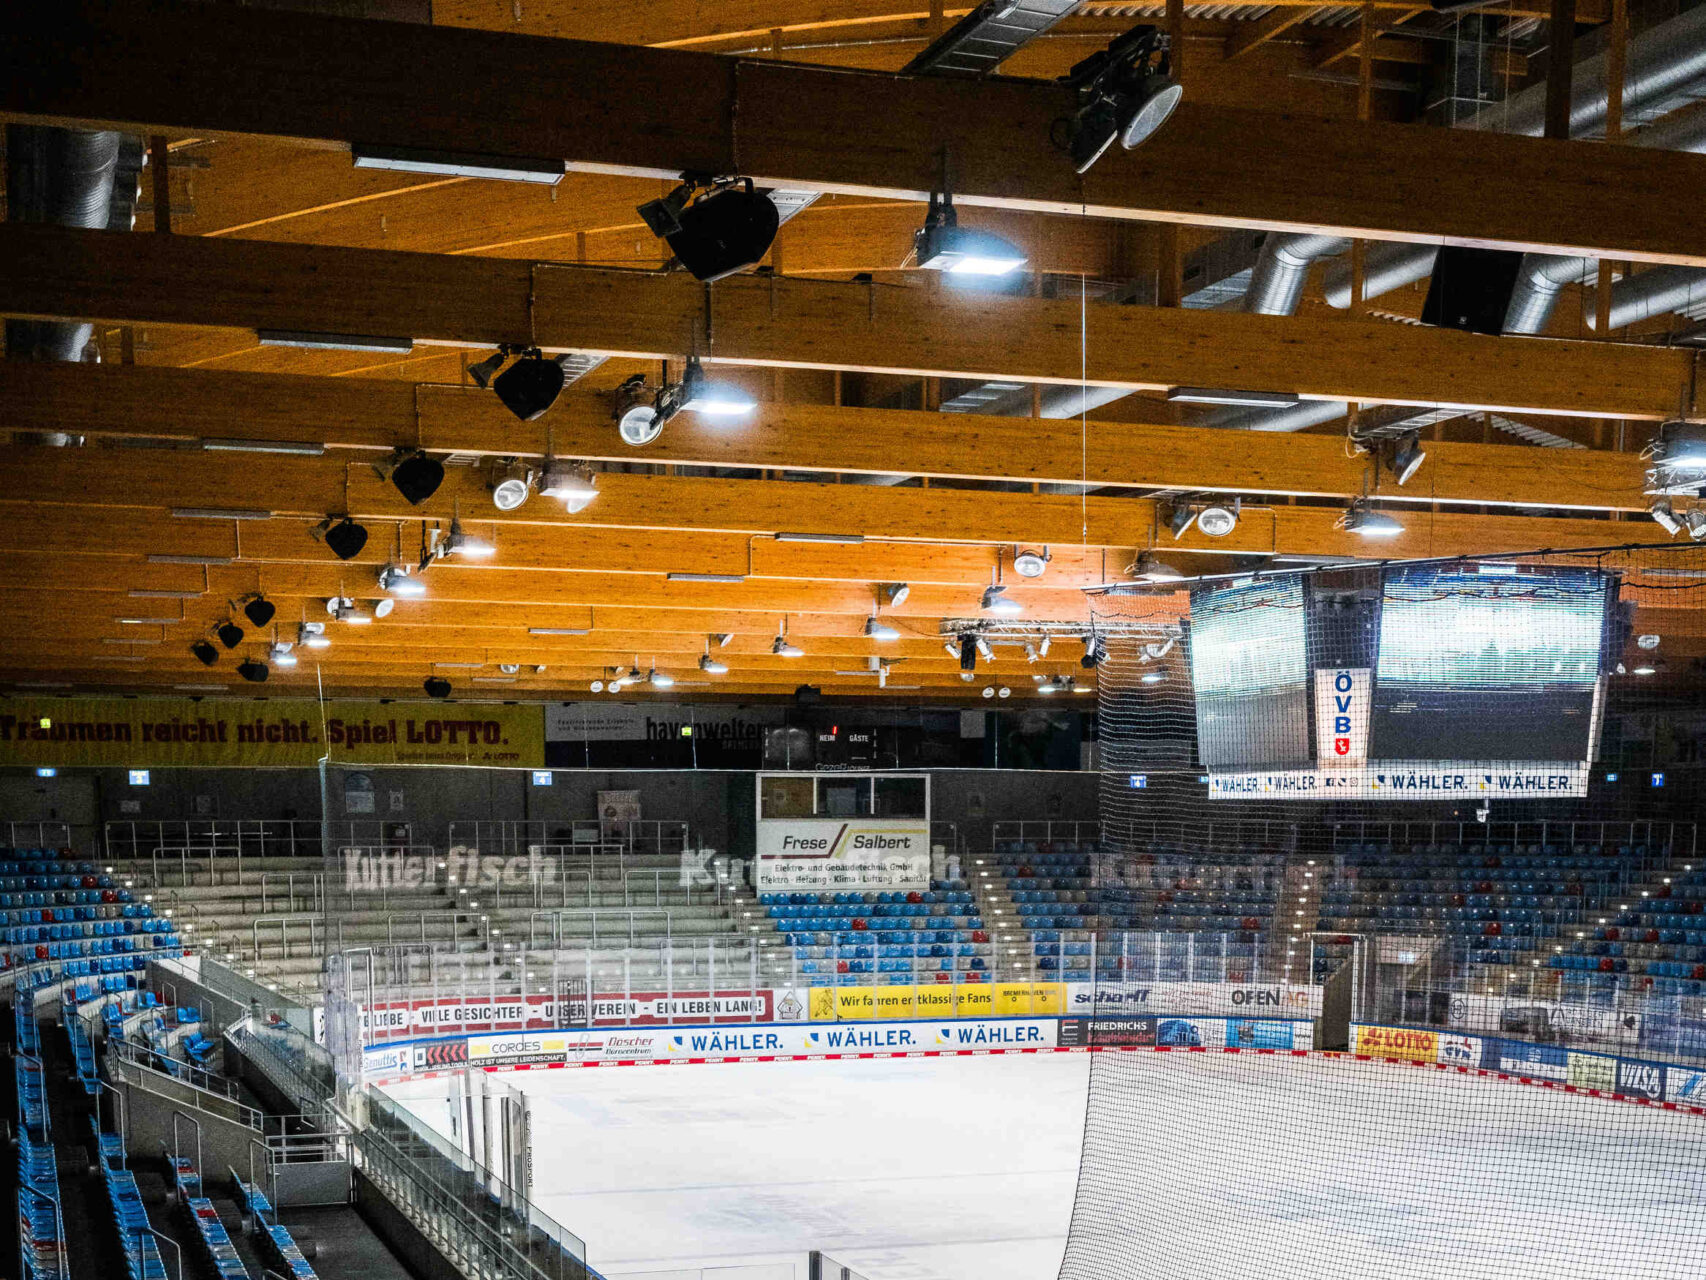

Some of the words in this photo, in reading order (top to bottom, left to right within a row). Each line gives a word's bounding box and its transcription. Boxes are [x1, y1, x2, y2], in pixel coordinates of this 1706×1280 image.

[142, 717, 229, 743] reicht
[237, 718, 319, 743] nicht.
[327, 719, 398, 749] Spiel
[406, 719, 509, 745] LOTTO.
[646, 716, 764, 740] havnwelte
[819, 734, 836, 742] HEIM
[1222, 774, 1260, 792] WÄHLER.
[1275, 773, 1317, 791] WÄHLER.
[1391, 771, 1468, 790] WÄHLER.
[1498, 771, 1572, 790] WÄHLER.
[782, 835, 827, 850] Frese
[853, 834, 911, 849] Salbert
[807, 863, 822, 872] und
[656, 1002, 677, 1014] EIN
[682, 1001, 721, 1014] LEBEN
[840, 996, 860, 1007] Wir
[901, 993, 965, 1007] ertklassie
[967, 993, 992, 1004] Fans
[958, 1025, 1044, 1044] WÄHLER.
[1087, 1021, 1147, 1031] FRIEDRICHS
[691, 1033, 784, 1052] WÄHLER.
[827, 1027, 917, 1048] WÄHLER.
[1384, 1030, 1432, 1051] LOTTO
